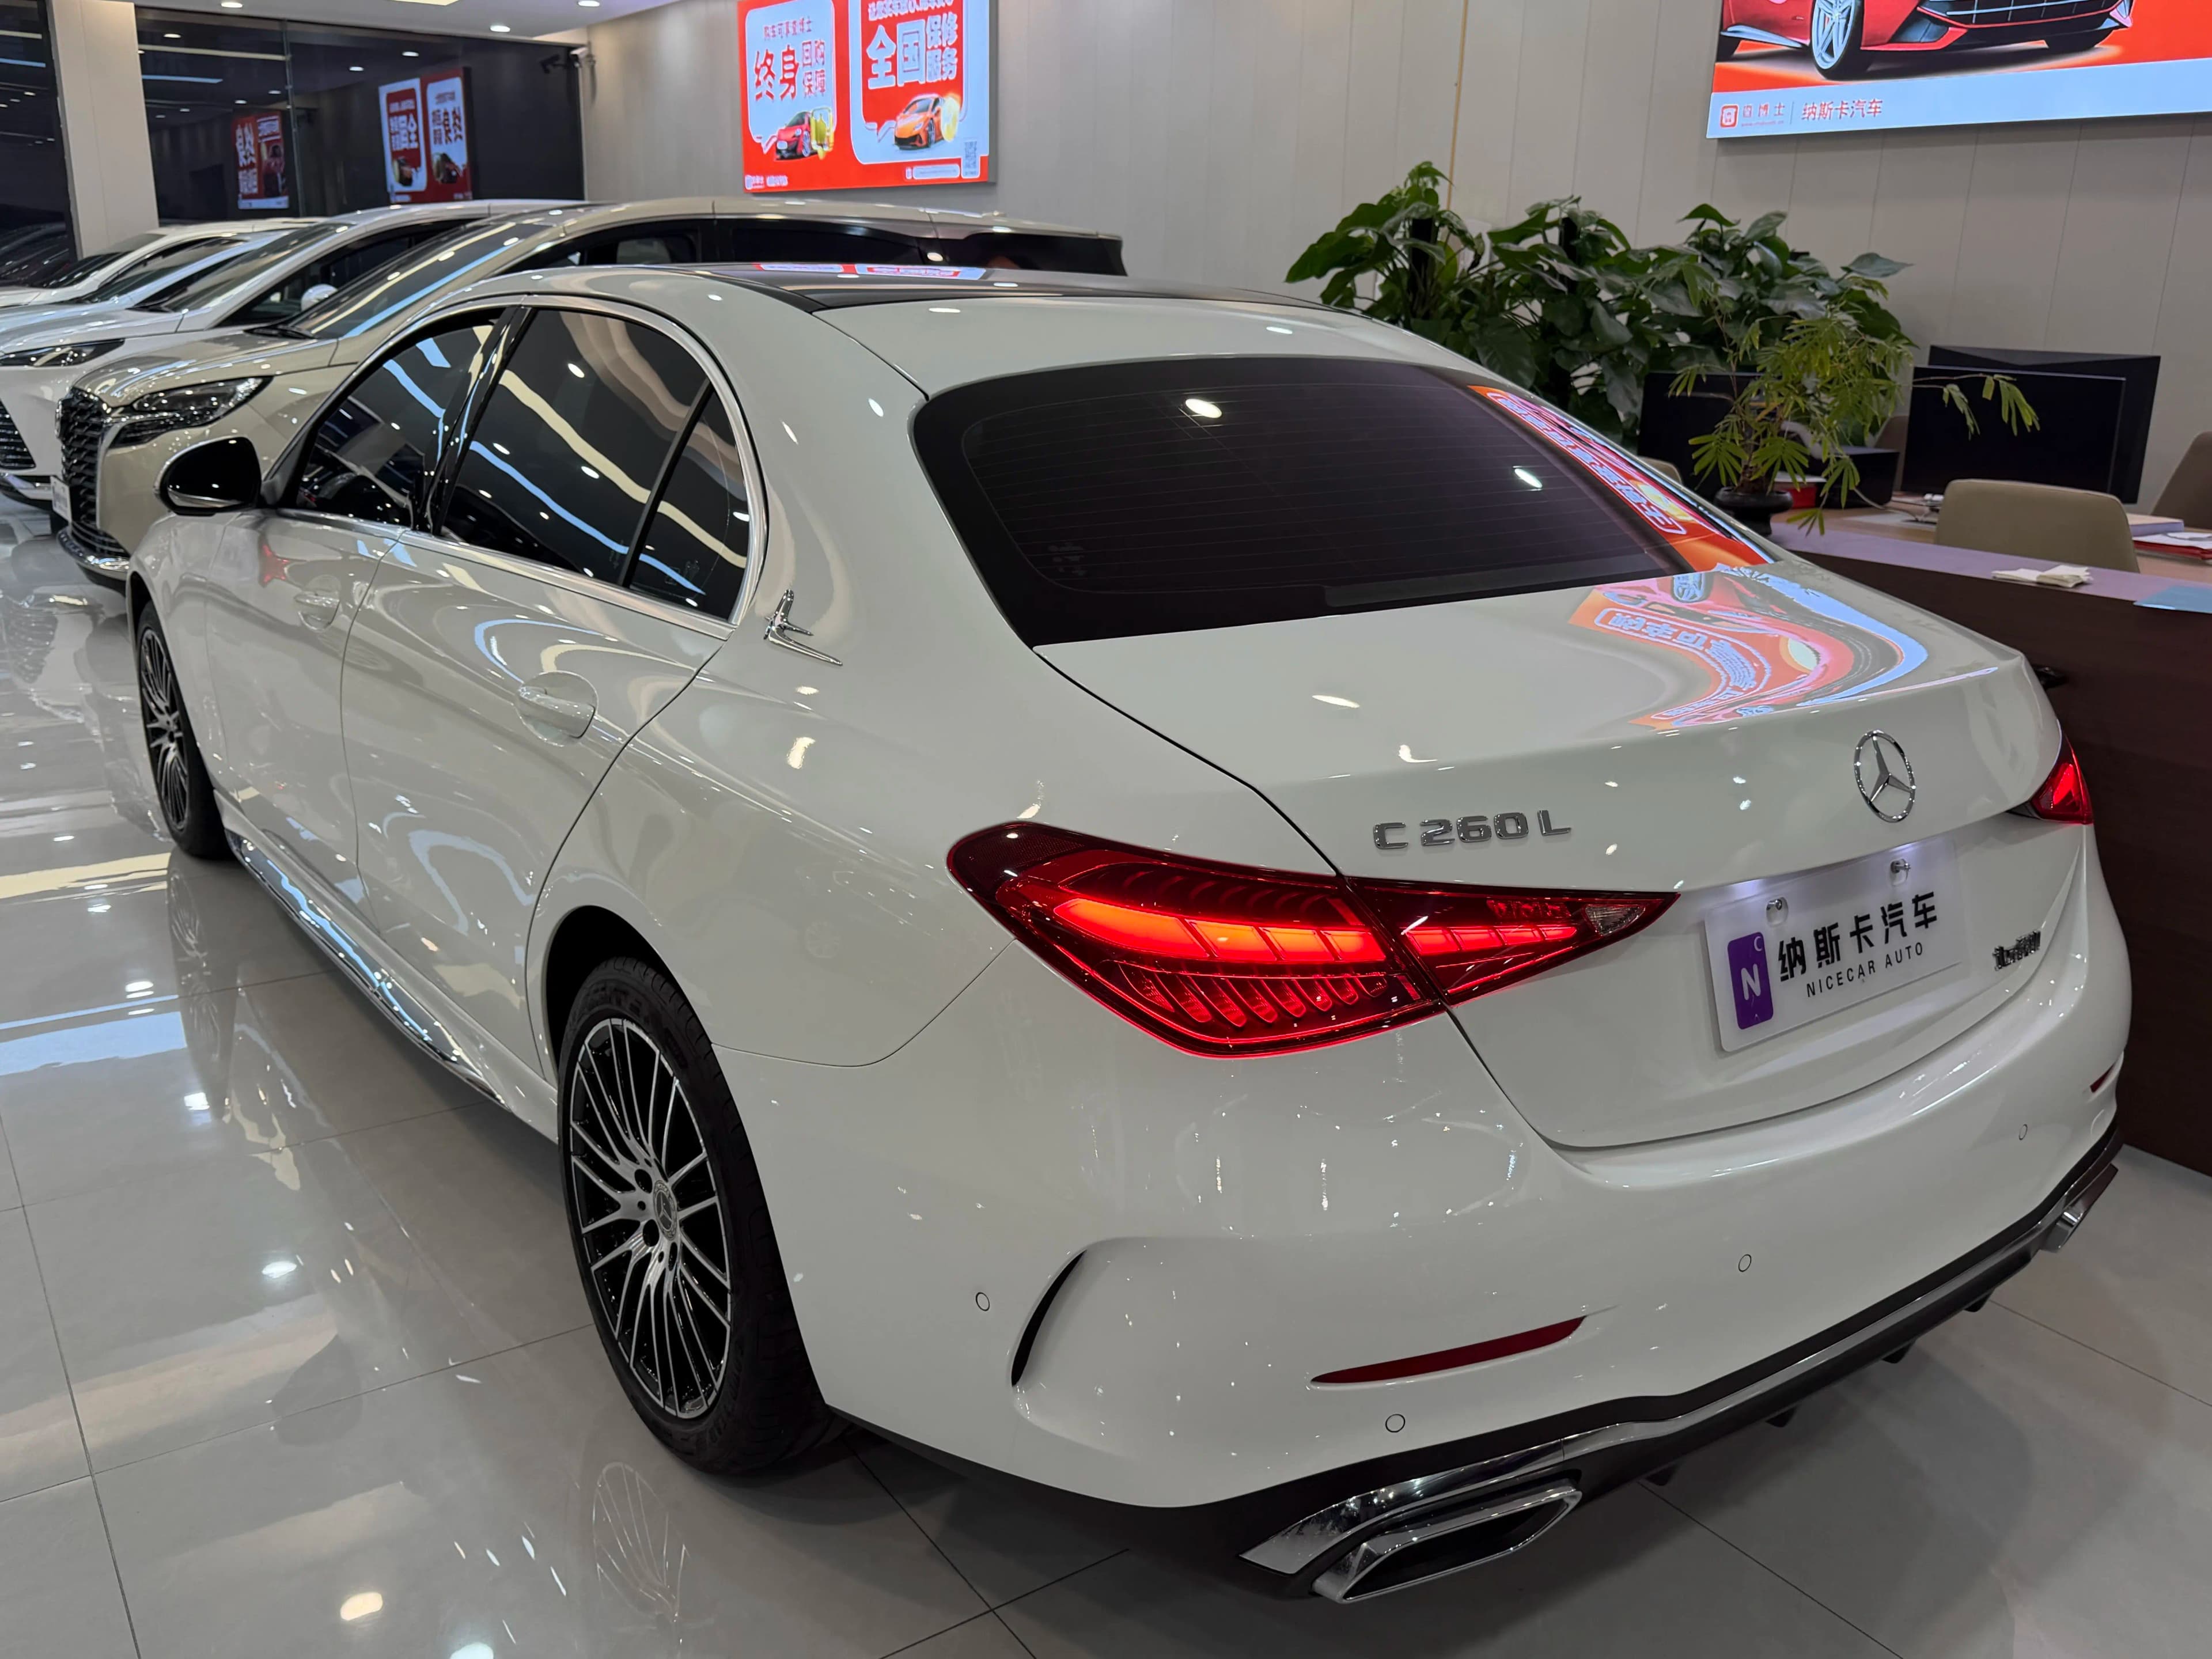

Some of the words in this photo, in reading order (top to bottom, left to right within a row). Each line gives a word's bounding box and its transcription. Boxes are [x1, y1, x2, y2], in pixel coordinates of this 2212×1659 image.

[926, 12, 959, 49] 保修
[755, 44, 799, 101] 终身
[802, 40, 825, 67] 回购
[866, 19, 926, 90] 全国
[926, 47, 959, 82] 服务
[802, 69, 825, 97] 保障
[1801, 97, 1883, 120] 纳斯卡汽车
[1373, 821, 1409, 850] C
[1419, 811, 1529, 847] 260
[1537, 809, 1572, 836] L
[1777, 891, 1938, 982] 纳斯卡汽车
[1741, 963, 1761, 1001] N
[1806, 959, 1876, 998] NICECAR
[1884, 941, 1923, 968] AUTO
